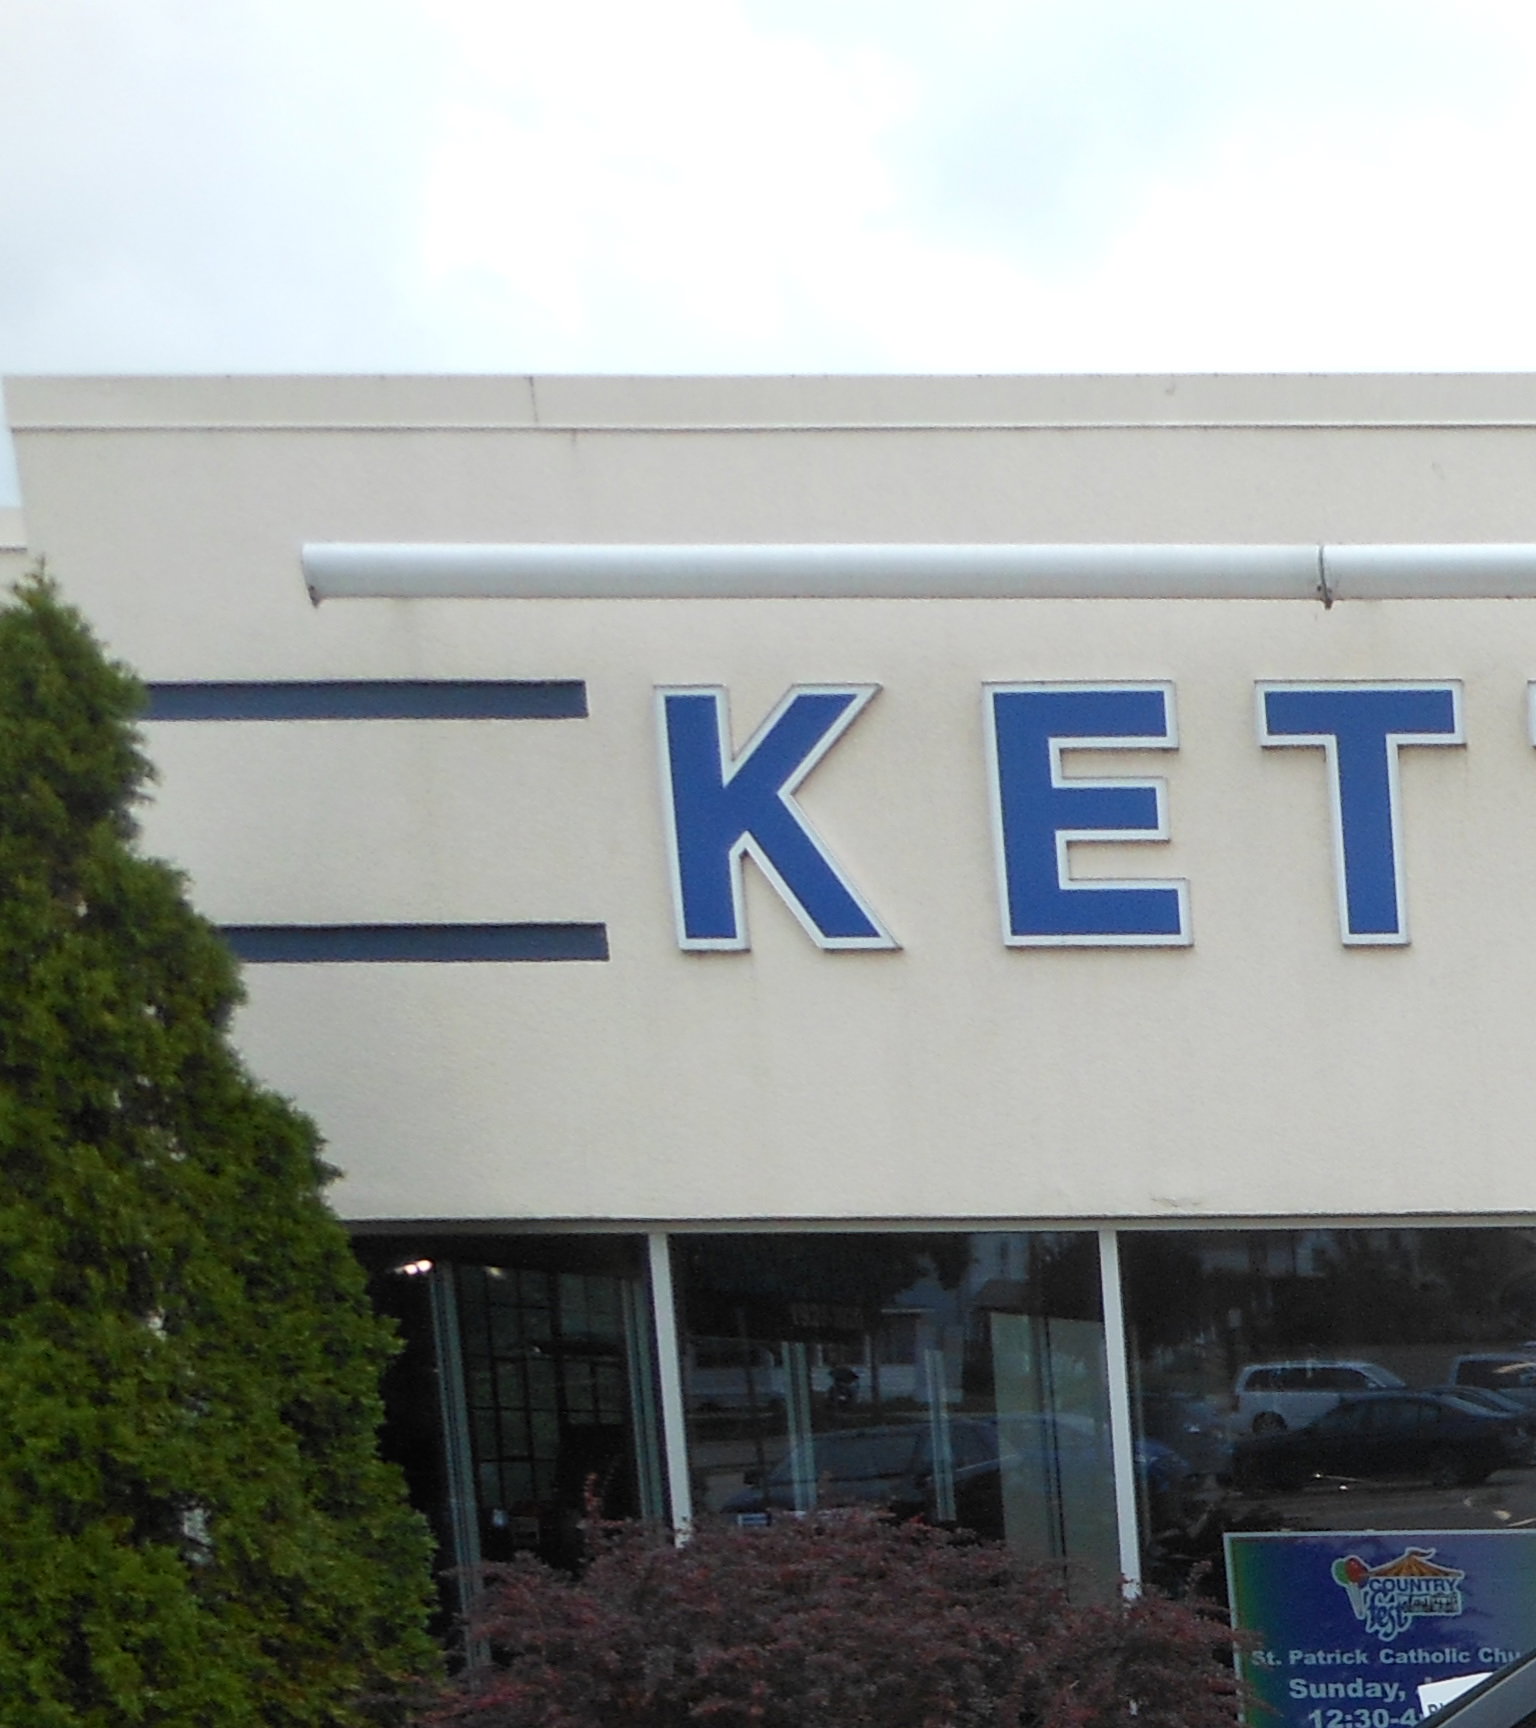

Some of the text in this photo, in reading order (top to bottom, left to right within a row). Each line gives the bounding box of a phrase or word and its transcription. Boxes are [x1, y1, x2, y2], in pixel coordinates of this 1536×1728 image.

[1369, 1578, 1455, 1592] COUNTRY
[1251, 1647, 1521, 1666] St. Patrick Catholic Chu
[1289, 1678, 1406, 1703] Sunday,
